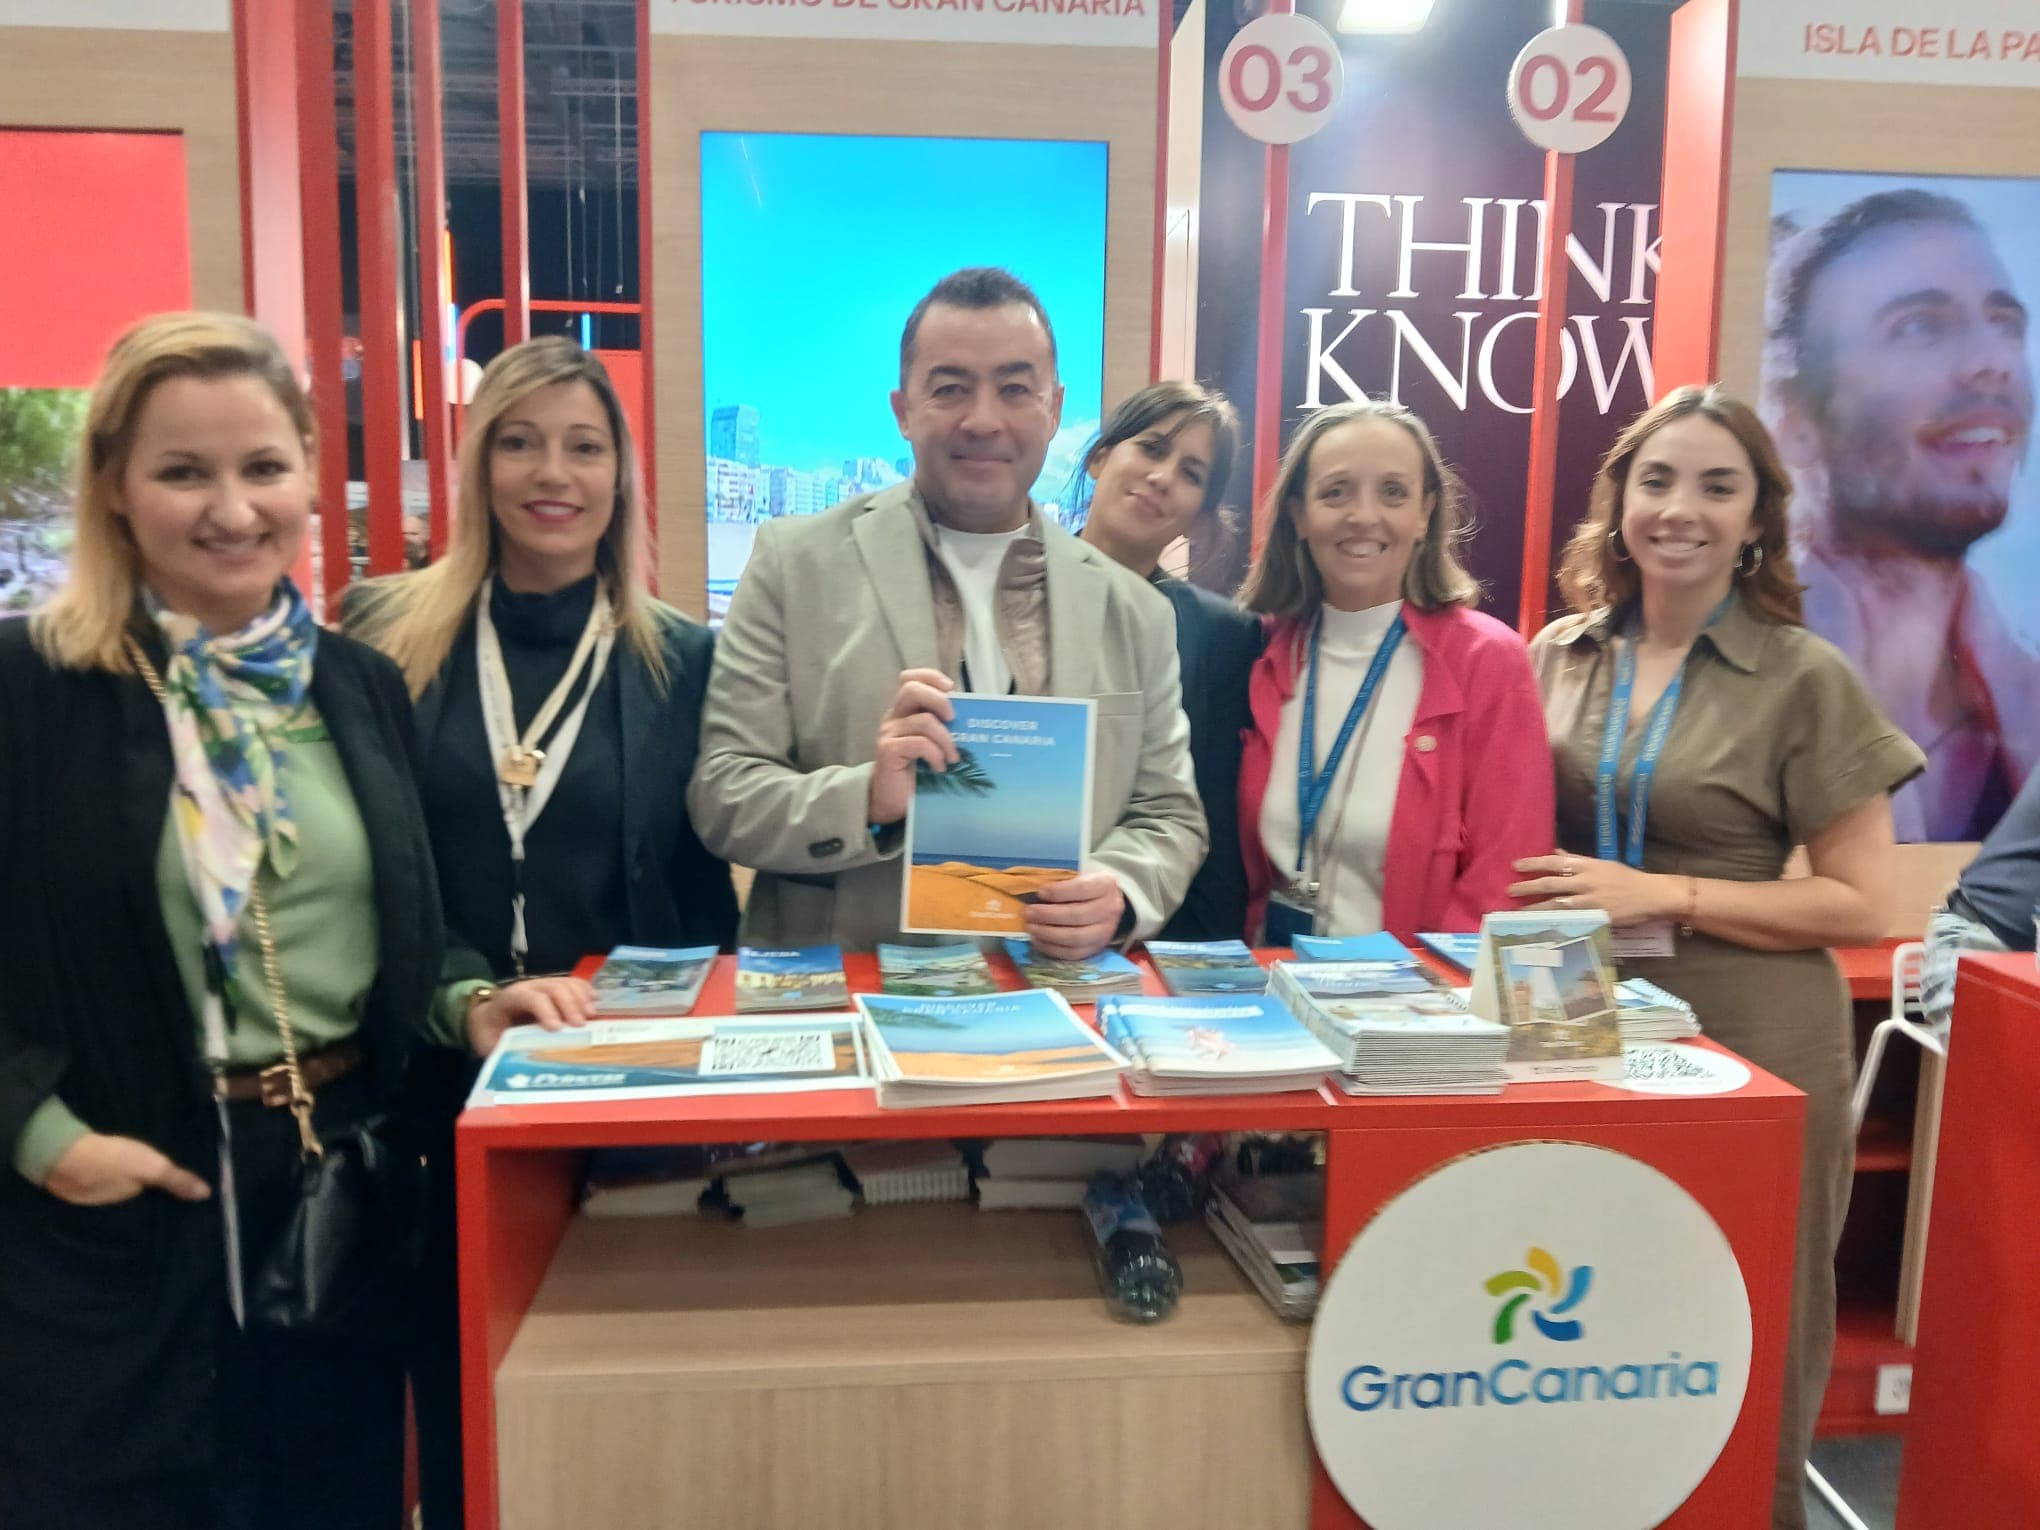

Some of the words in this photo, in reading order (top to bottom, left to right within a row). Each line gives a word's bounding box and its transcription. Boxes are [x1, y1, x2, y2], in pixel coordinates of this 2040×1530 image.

[1803, 22, 1882, 56] ISLA
[1889, 27, 1940, 58] DE
[1946, 28, 1992, 60] LA
[1999, 30, 2040, 62] PA
[1228, 44, 1333, 113] 03
[1518, 54, 1618, 123] 02
[966, 718, 1040, 731] DISCOVER
[992, 734, 1056, 746] CANARIA
[1340, 1352, 1719, 1412] GranCanaria
